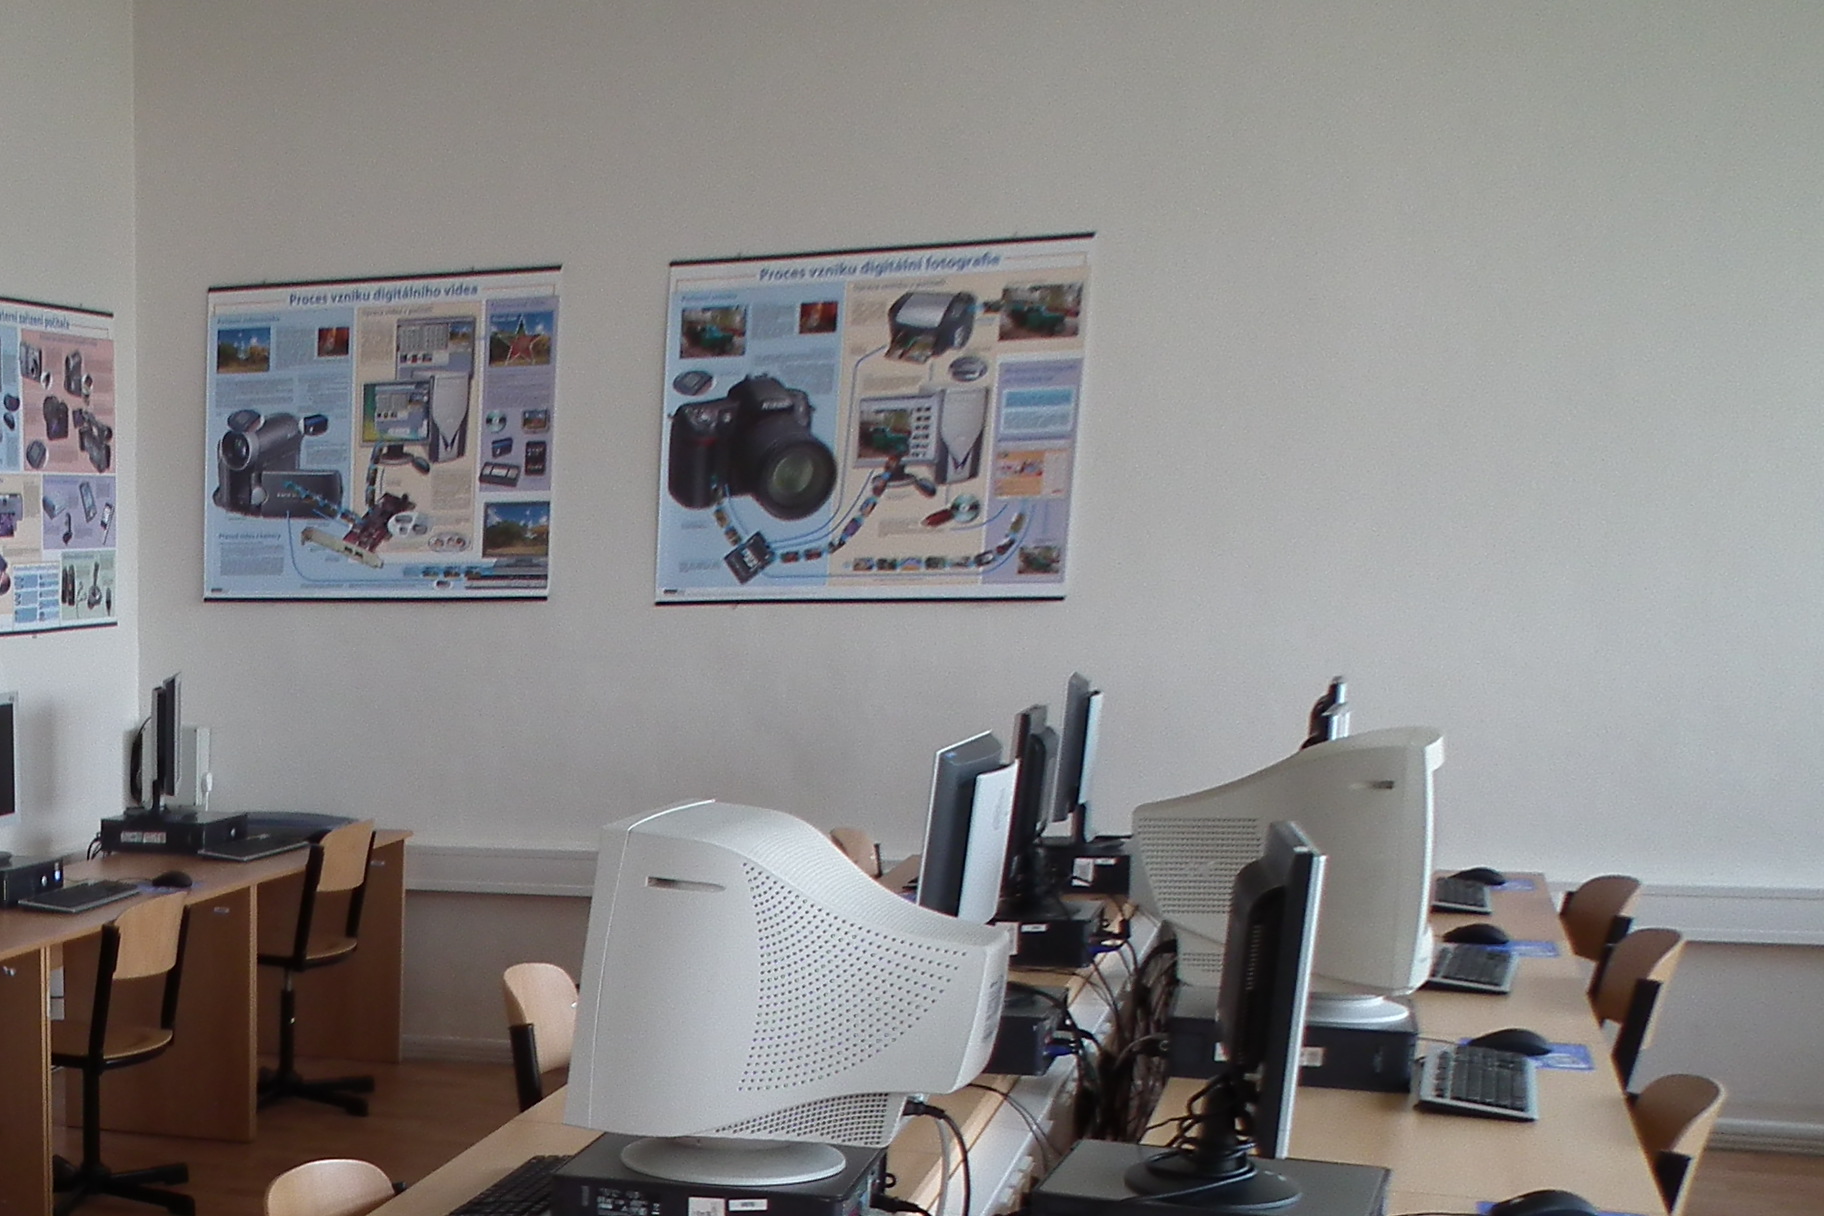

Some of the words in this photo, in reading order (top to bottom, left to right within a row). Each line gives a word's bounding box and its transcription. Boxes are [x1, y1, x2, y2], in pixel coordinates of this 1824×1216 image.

[759, 267, 805, 281] Proces
[809, 262, 858, 278] vzniku
[925, 251, 1002, 273] fotografie
[289, 293, 328, 306] Proces
[330, 290, 371, 304] vzniku
[373, 285, 441, 303] digitálního
[444, 283, 478, 296] videa
